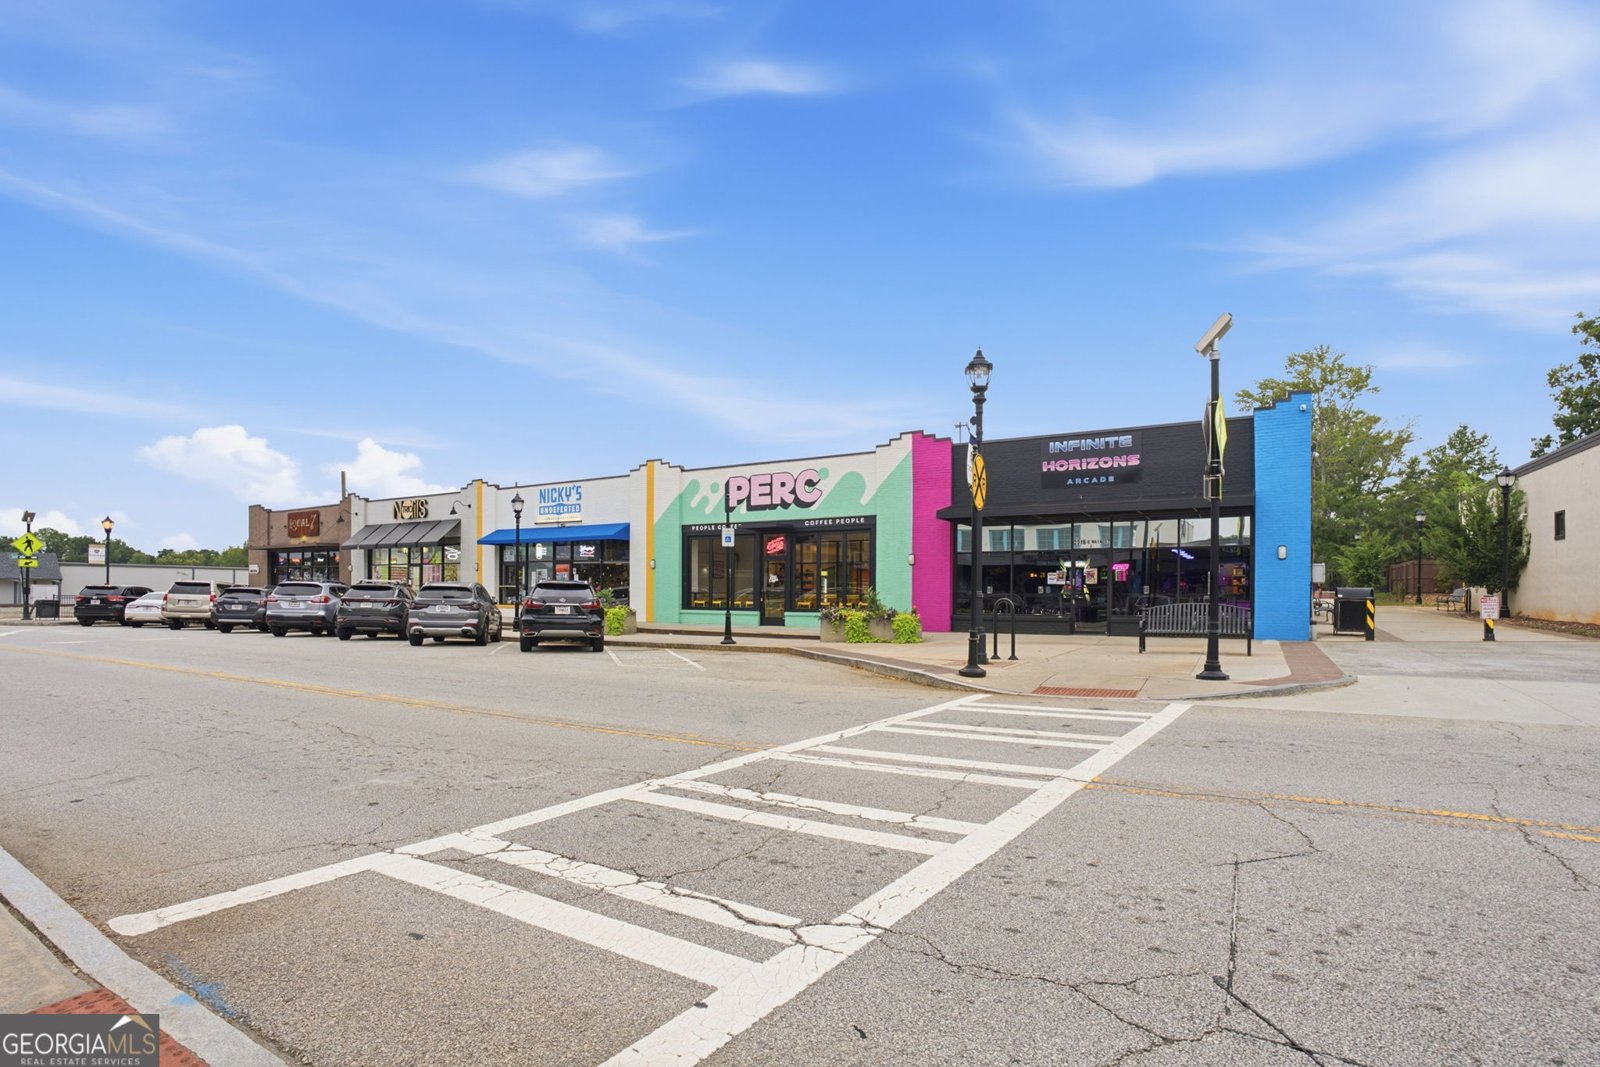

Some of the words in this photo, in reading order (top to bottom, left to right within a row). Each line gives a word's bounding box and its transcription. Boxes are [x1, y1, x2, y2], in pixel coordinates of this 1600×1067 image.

[1049, 435, 1133, 453] INFINITE
[1042, 454, 1140, 472] HORIZONS
[1066, 475, 1115, 485] ARCADE
[539, 484, 582, 504] NICKY'S
[726, 468, 823, 511] PERC
[540, 504, 580, 514] UNDEFEATED
[289, 518, 310, 532] LOCAL
[310, 513, 317, 530] 7
[835, 517, 865, 525] PEOPLE
